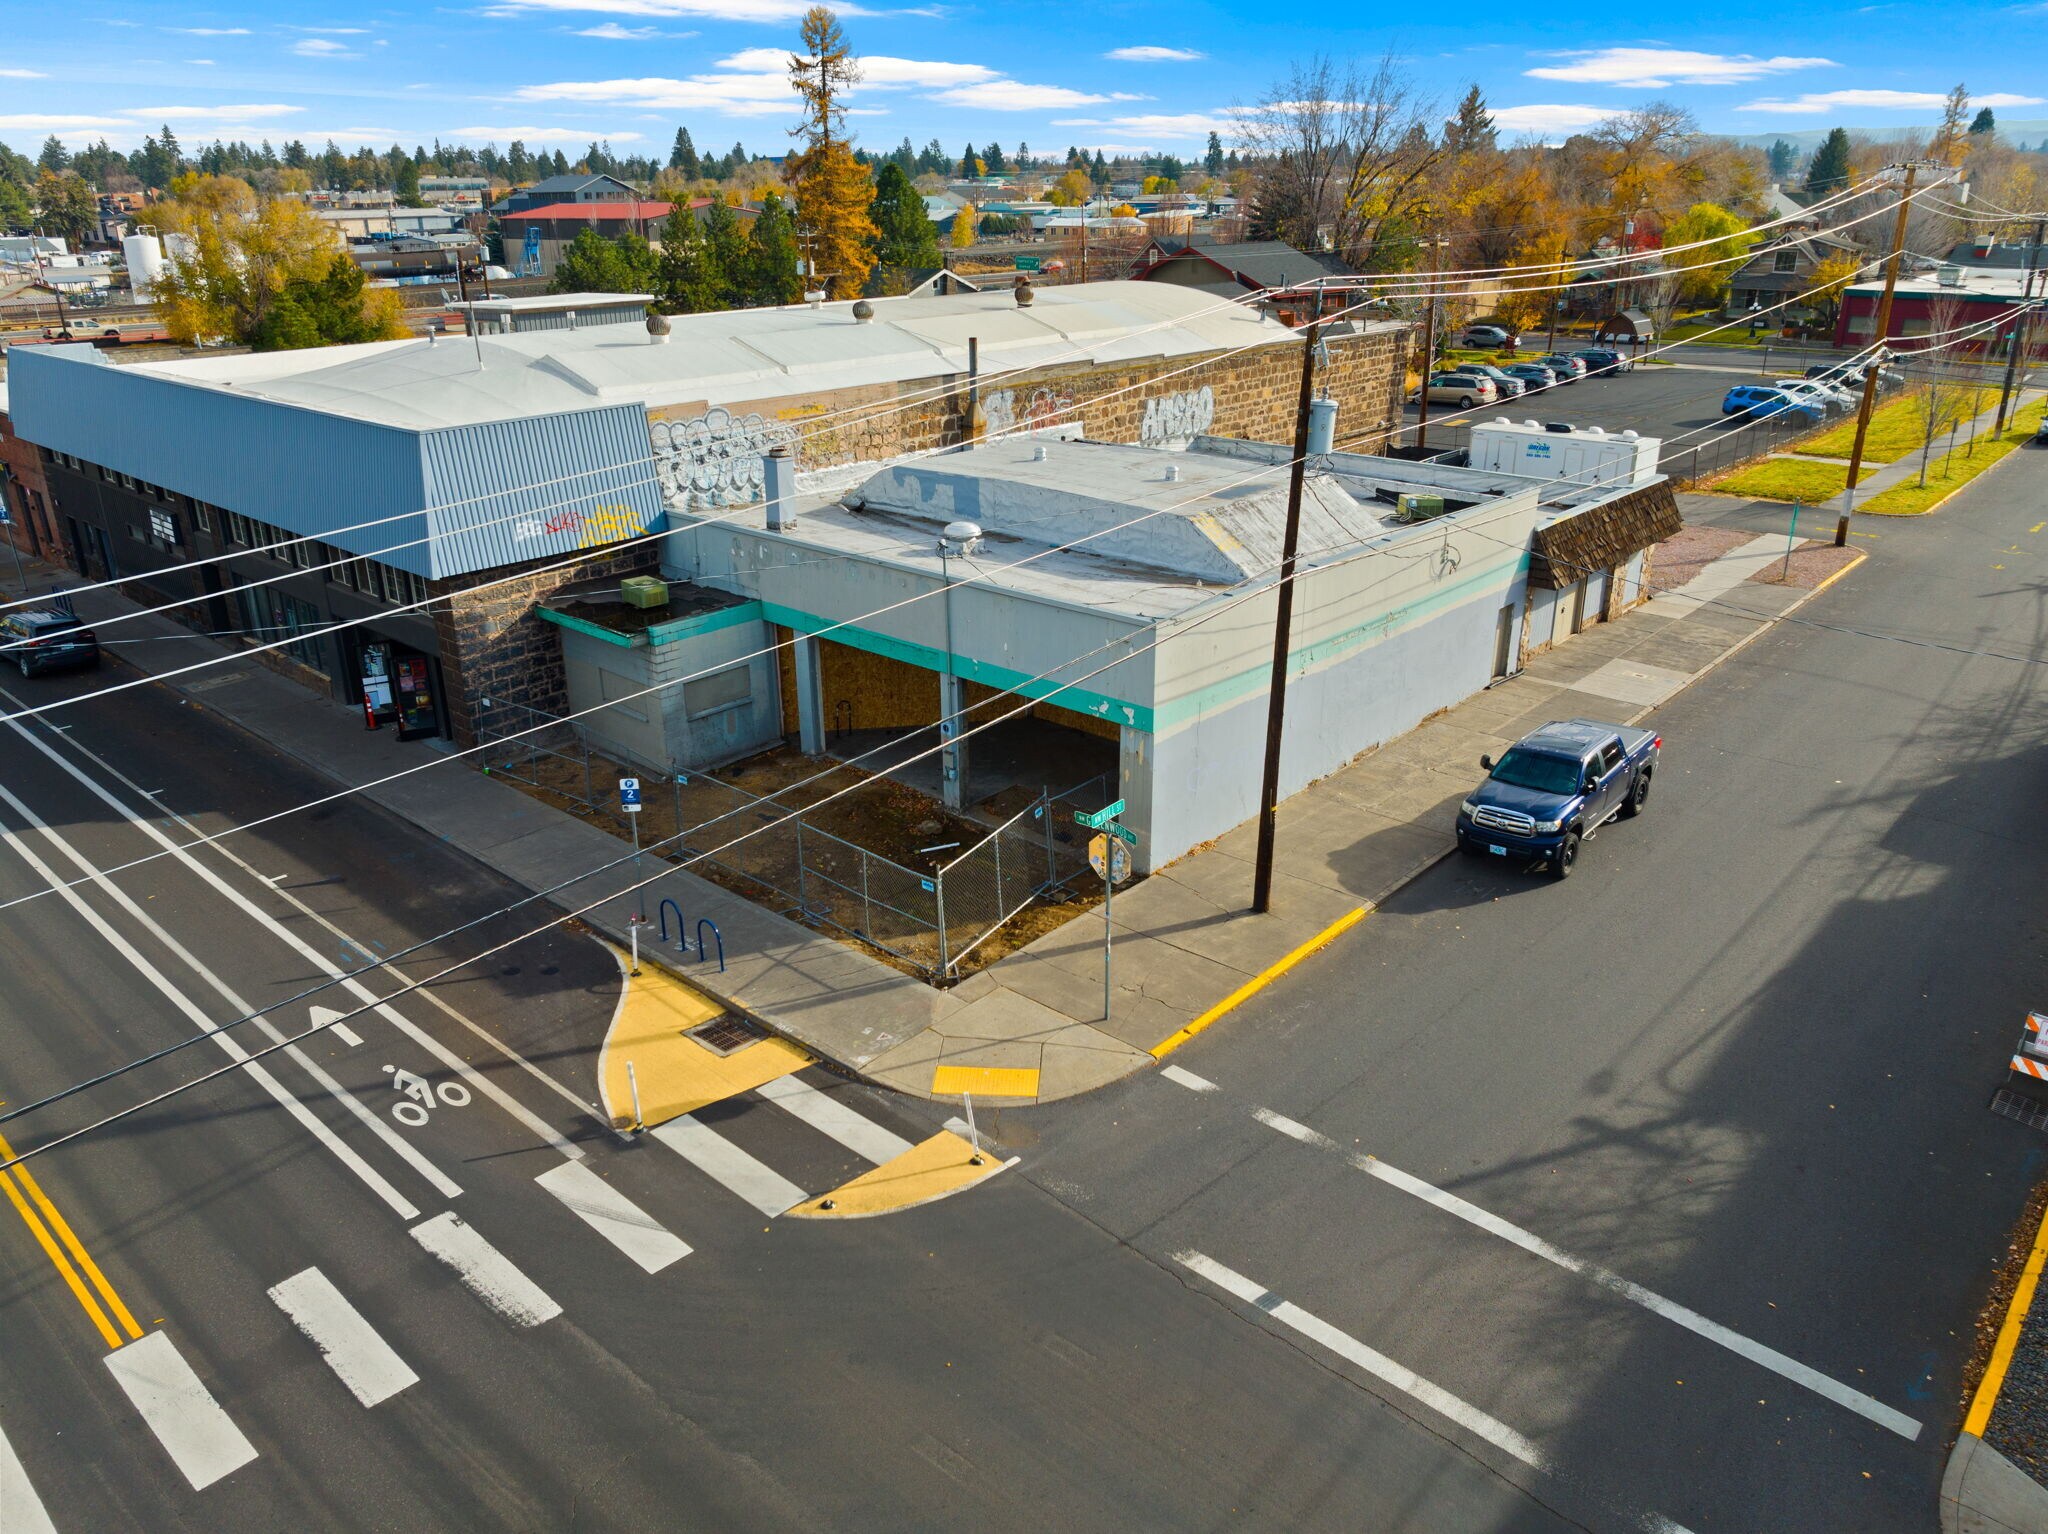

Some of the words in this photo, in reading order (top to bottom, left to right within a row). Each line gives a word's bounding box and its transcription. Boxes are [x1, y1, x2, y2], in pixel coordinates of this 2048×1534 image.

[627, 790, 634, 798] 2
[1102, 806, 1116, 821] HILL
[1086, 816, 1128, 838] GENWOOD
